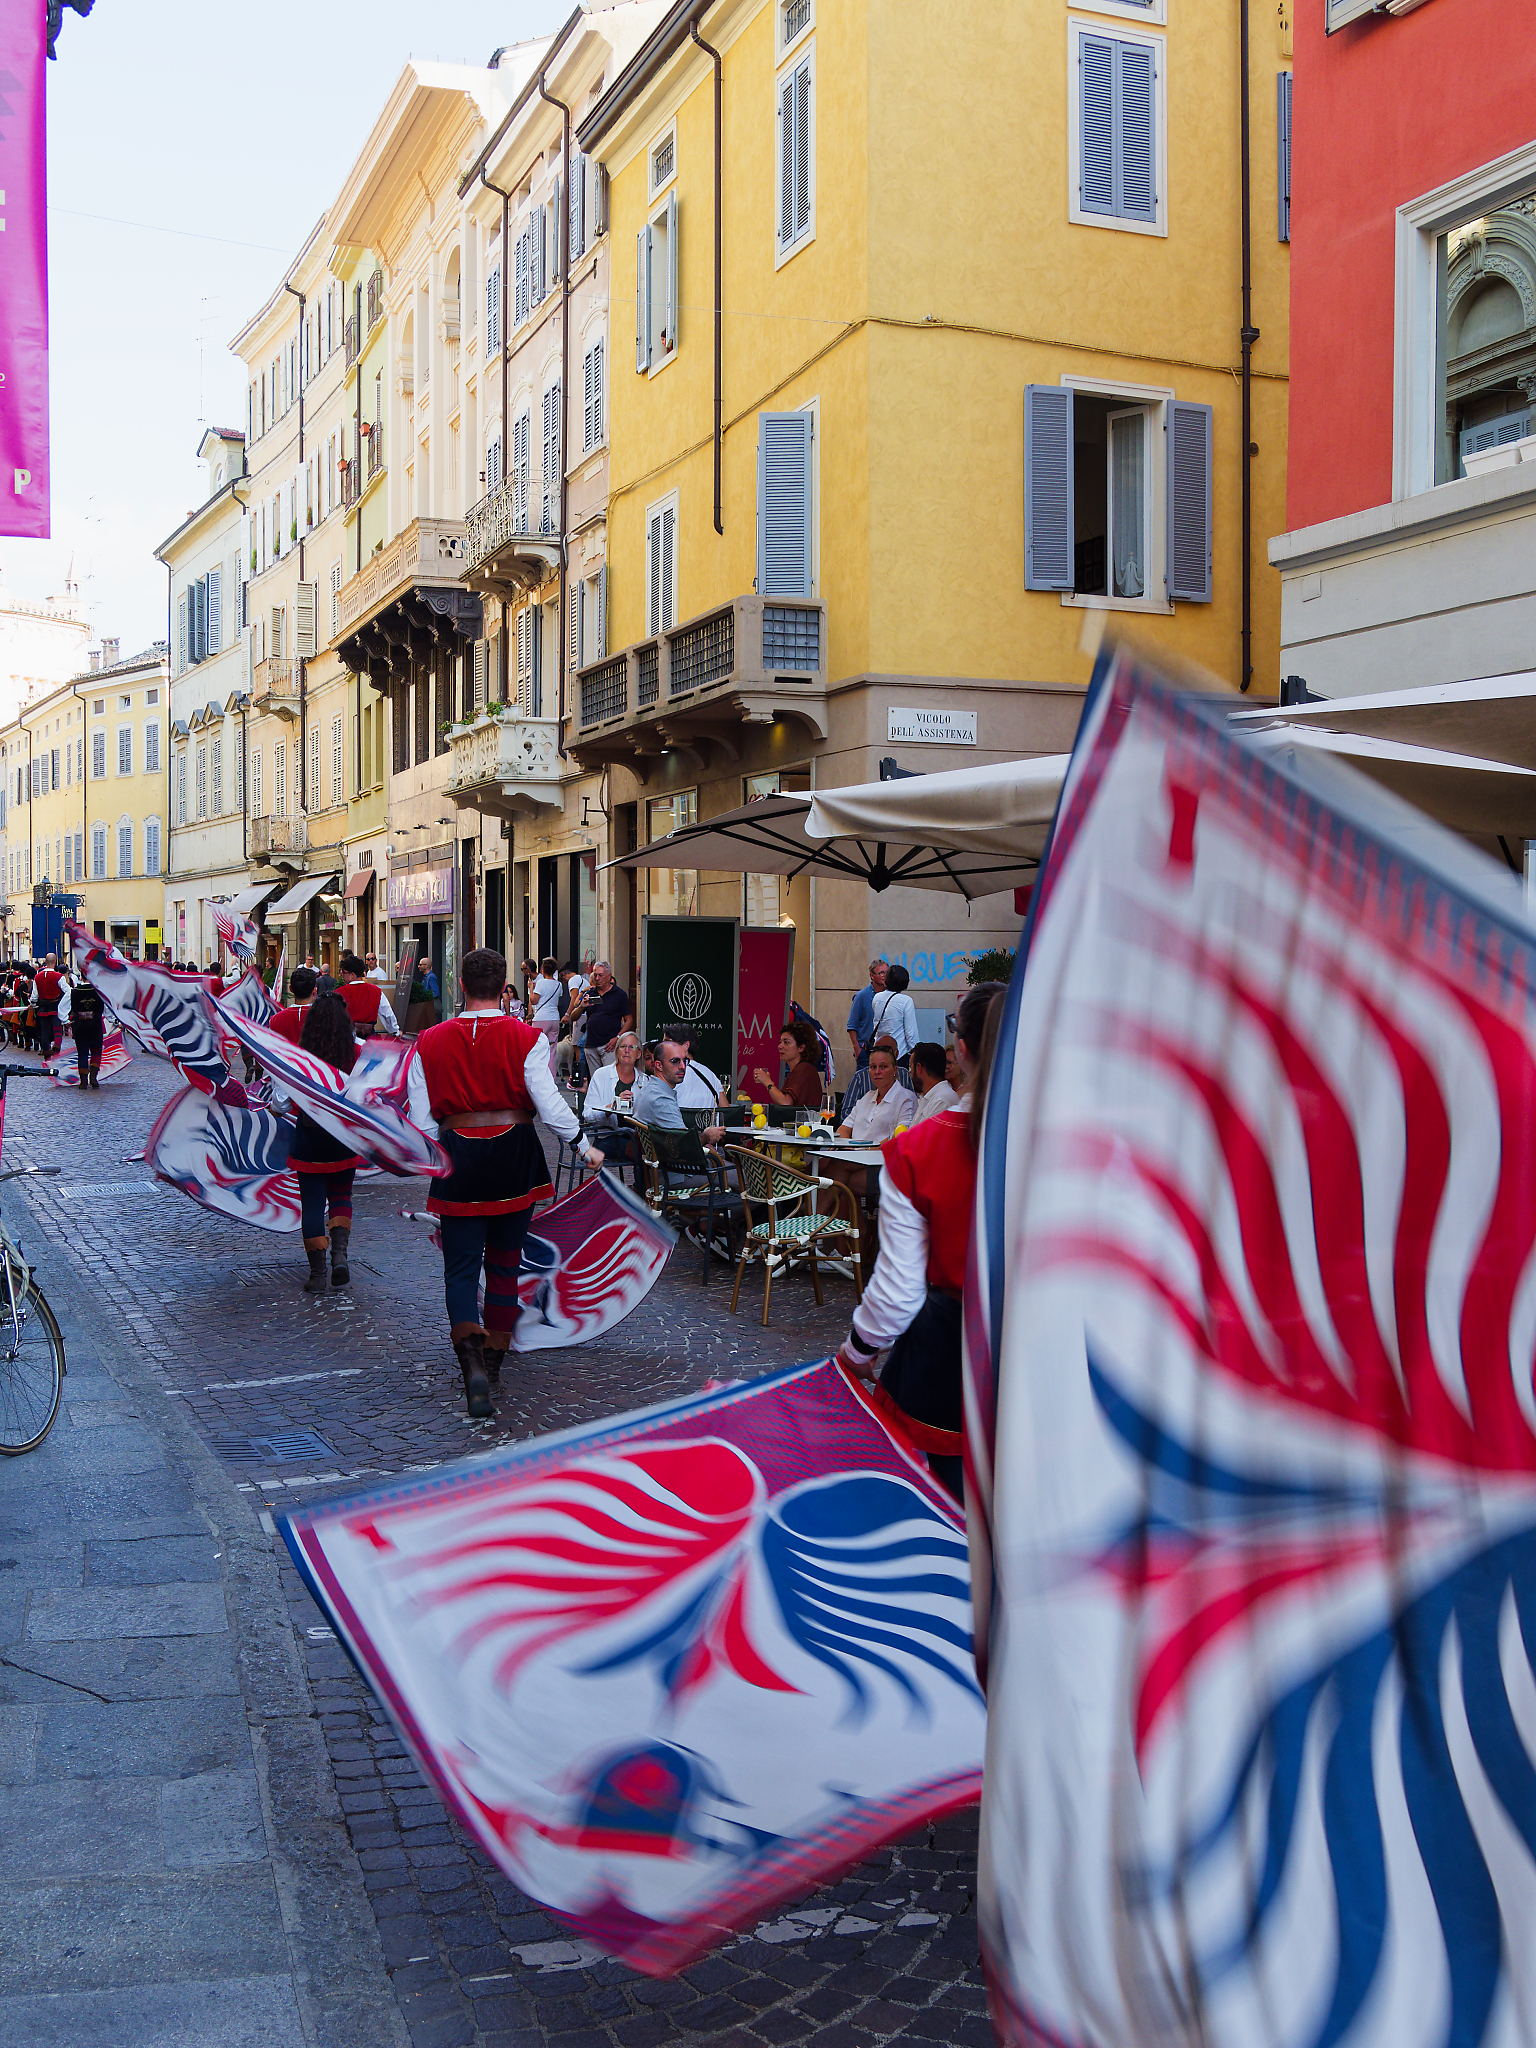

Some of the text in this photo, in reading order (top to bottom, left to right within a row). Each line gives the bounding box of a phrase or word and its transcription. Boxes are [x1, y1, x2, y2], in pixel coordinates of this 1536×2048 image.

[916, 713, 951, 725] VICOLO
[891, 725, 974, 740] DELL' ASSISTENZA
